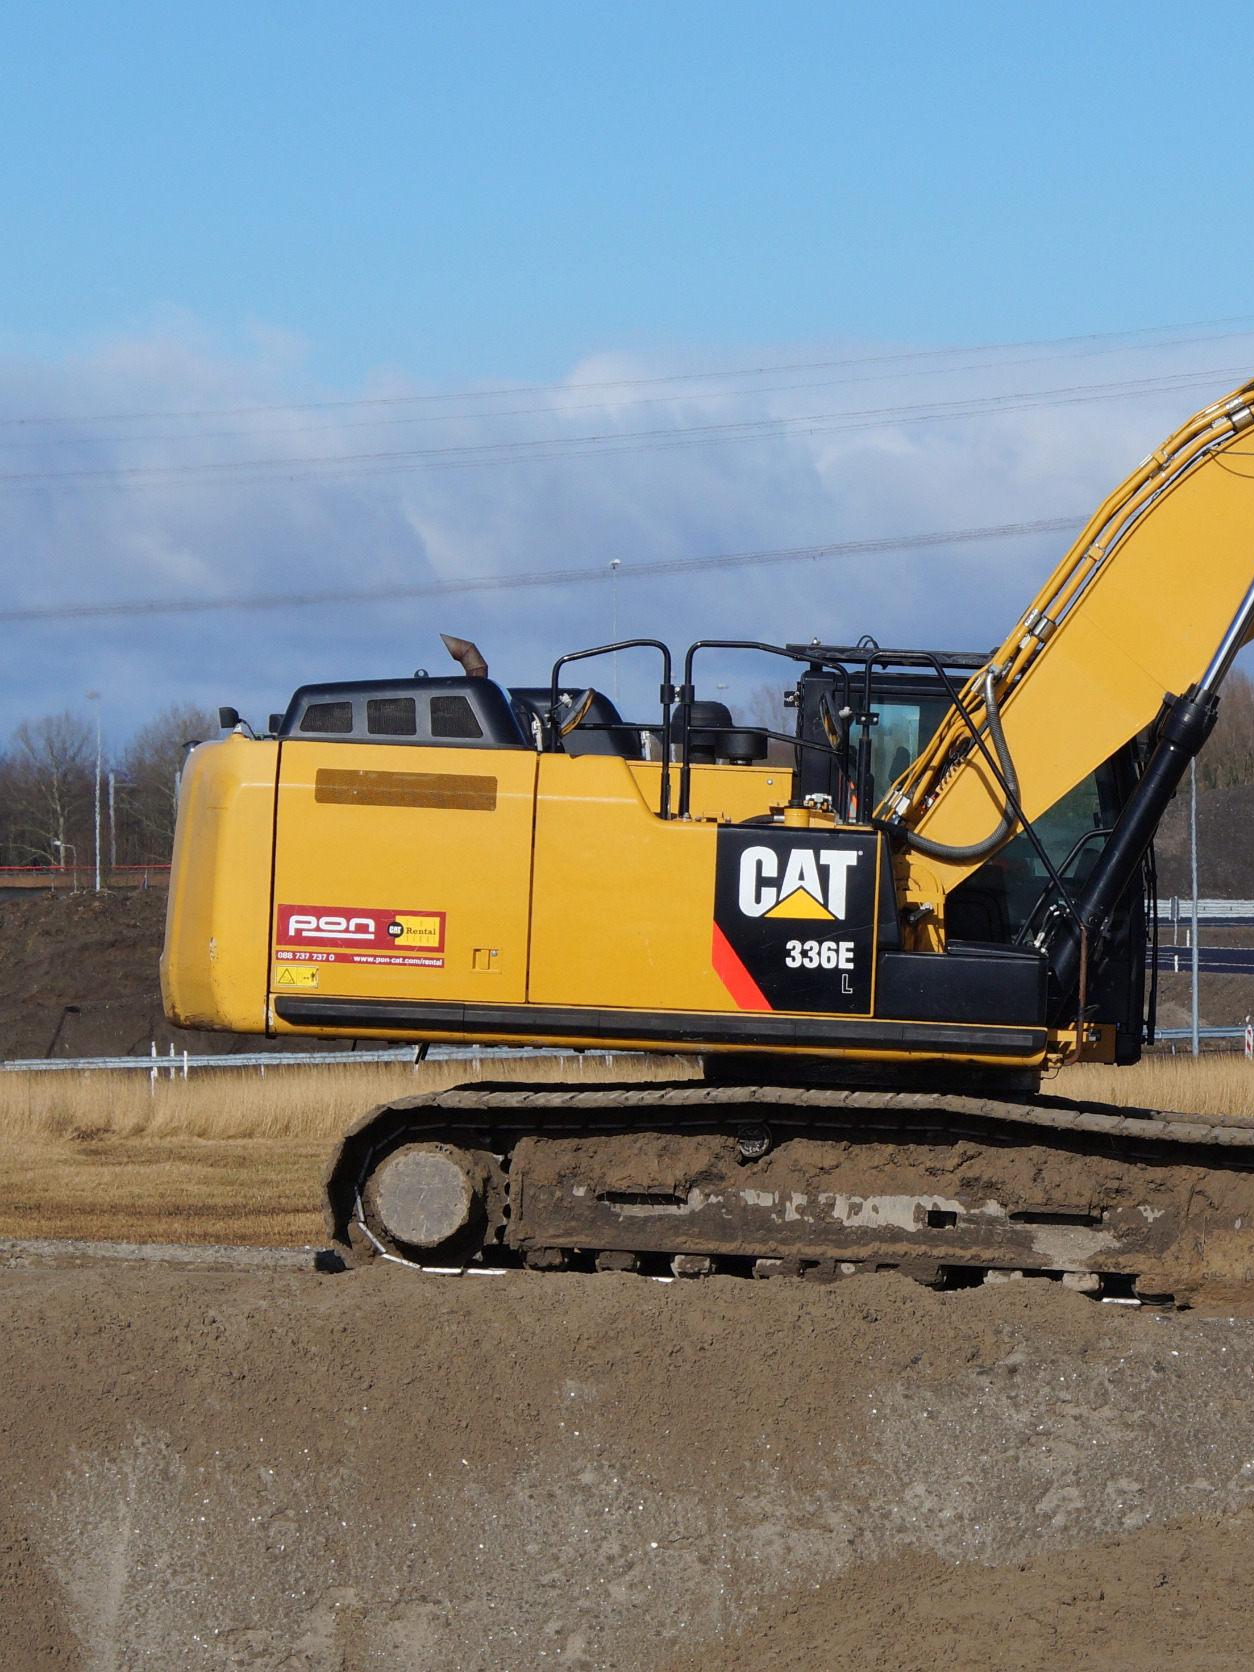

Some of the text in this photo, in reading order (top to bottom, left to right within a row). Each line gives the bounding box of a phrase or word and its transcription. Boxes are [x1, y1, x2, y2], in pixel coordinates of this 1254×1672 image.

[739, 846, 858, 920] CAT
[406, 927, 436, 935] Rental
[277, 951, 293, 959] 088
[295, 952, 310, 960] 737
[312, 953, 327, 961] 737
[353, 955, 443, 966] www.pon-cat.com/rental
[785, 940, 854, 969] 336E
[841, 973, 853, 994] L
